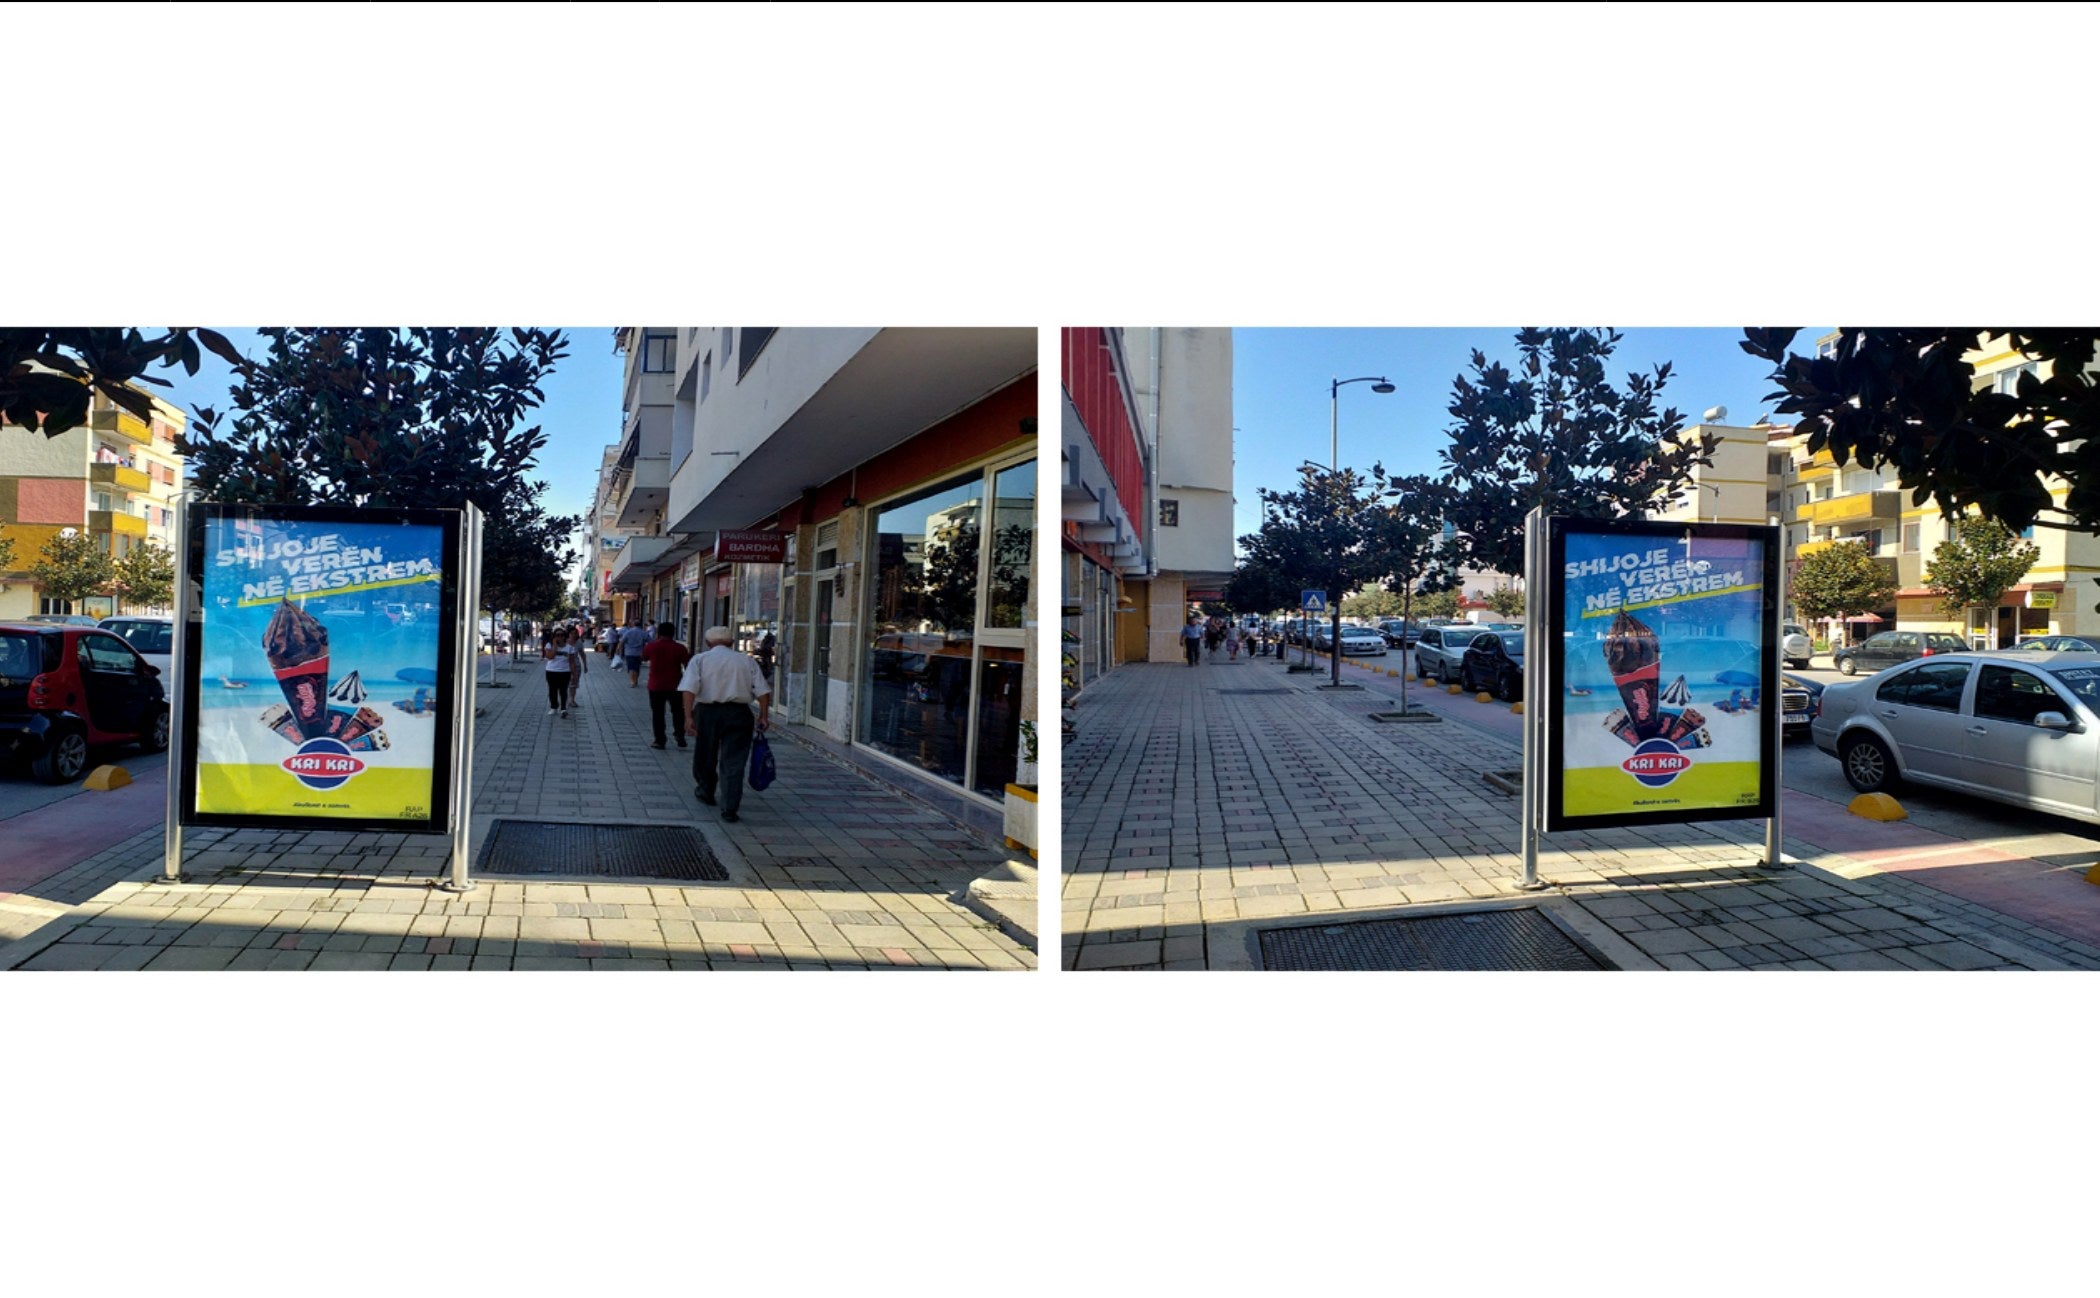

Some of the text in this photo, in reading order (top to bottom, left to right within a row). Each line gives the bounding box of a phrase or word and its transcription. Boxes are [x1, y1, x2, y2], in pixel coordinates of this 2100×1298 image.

[281, 546, 383, 576] VERËN
[728, 543, 780, 553] BARDHA
[242, 557, 434, 601] NË EKSTREM
[1564, 548, 1669, 580] SHIJOJE
[1585, 570, 1744, 611] NË EKSTREM
[290, 757, 356, 771] KRI KRI
[1628, 757, 1683, 770] KRI KRI
